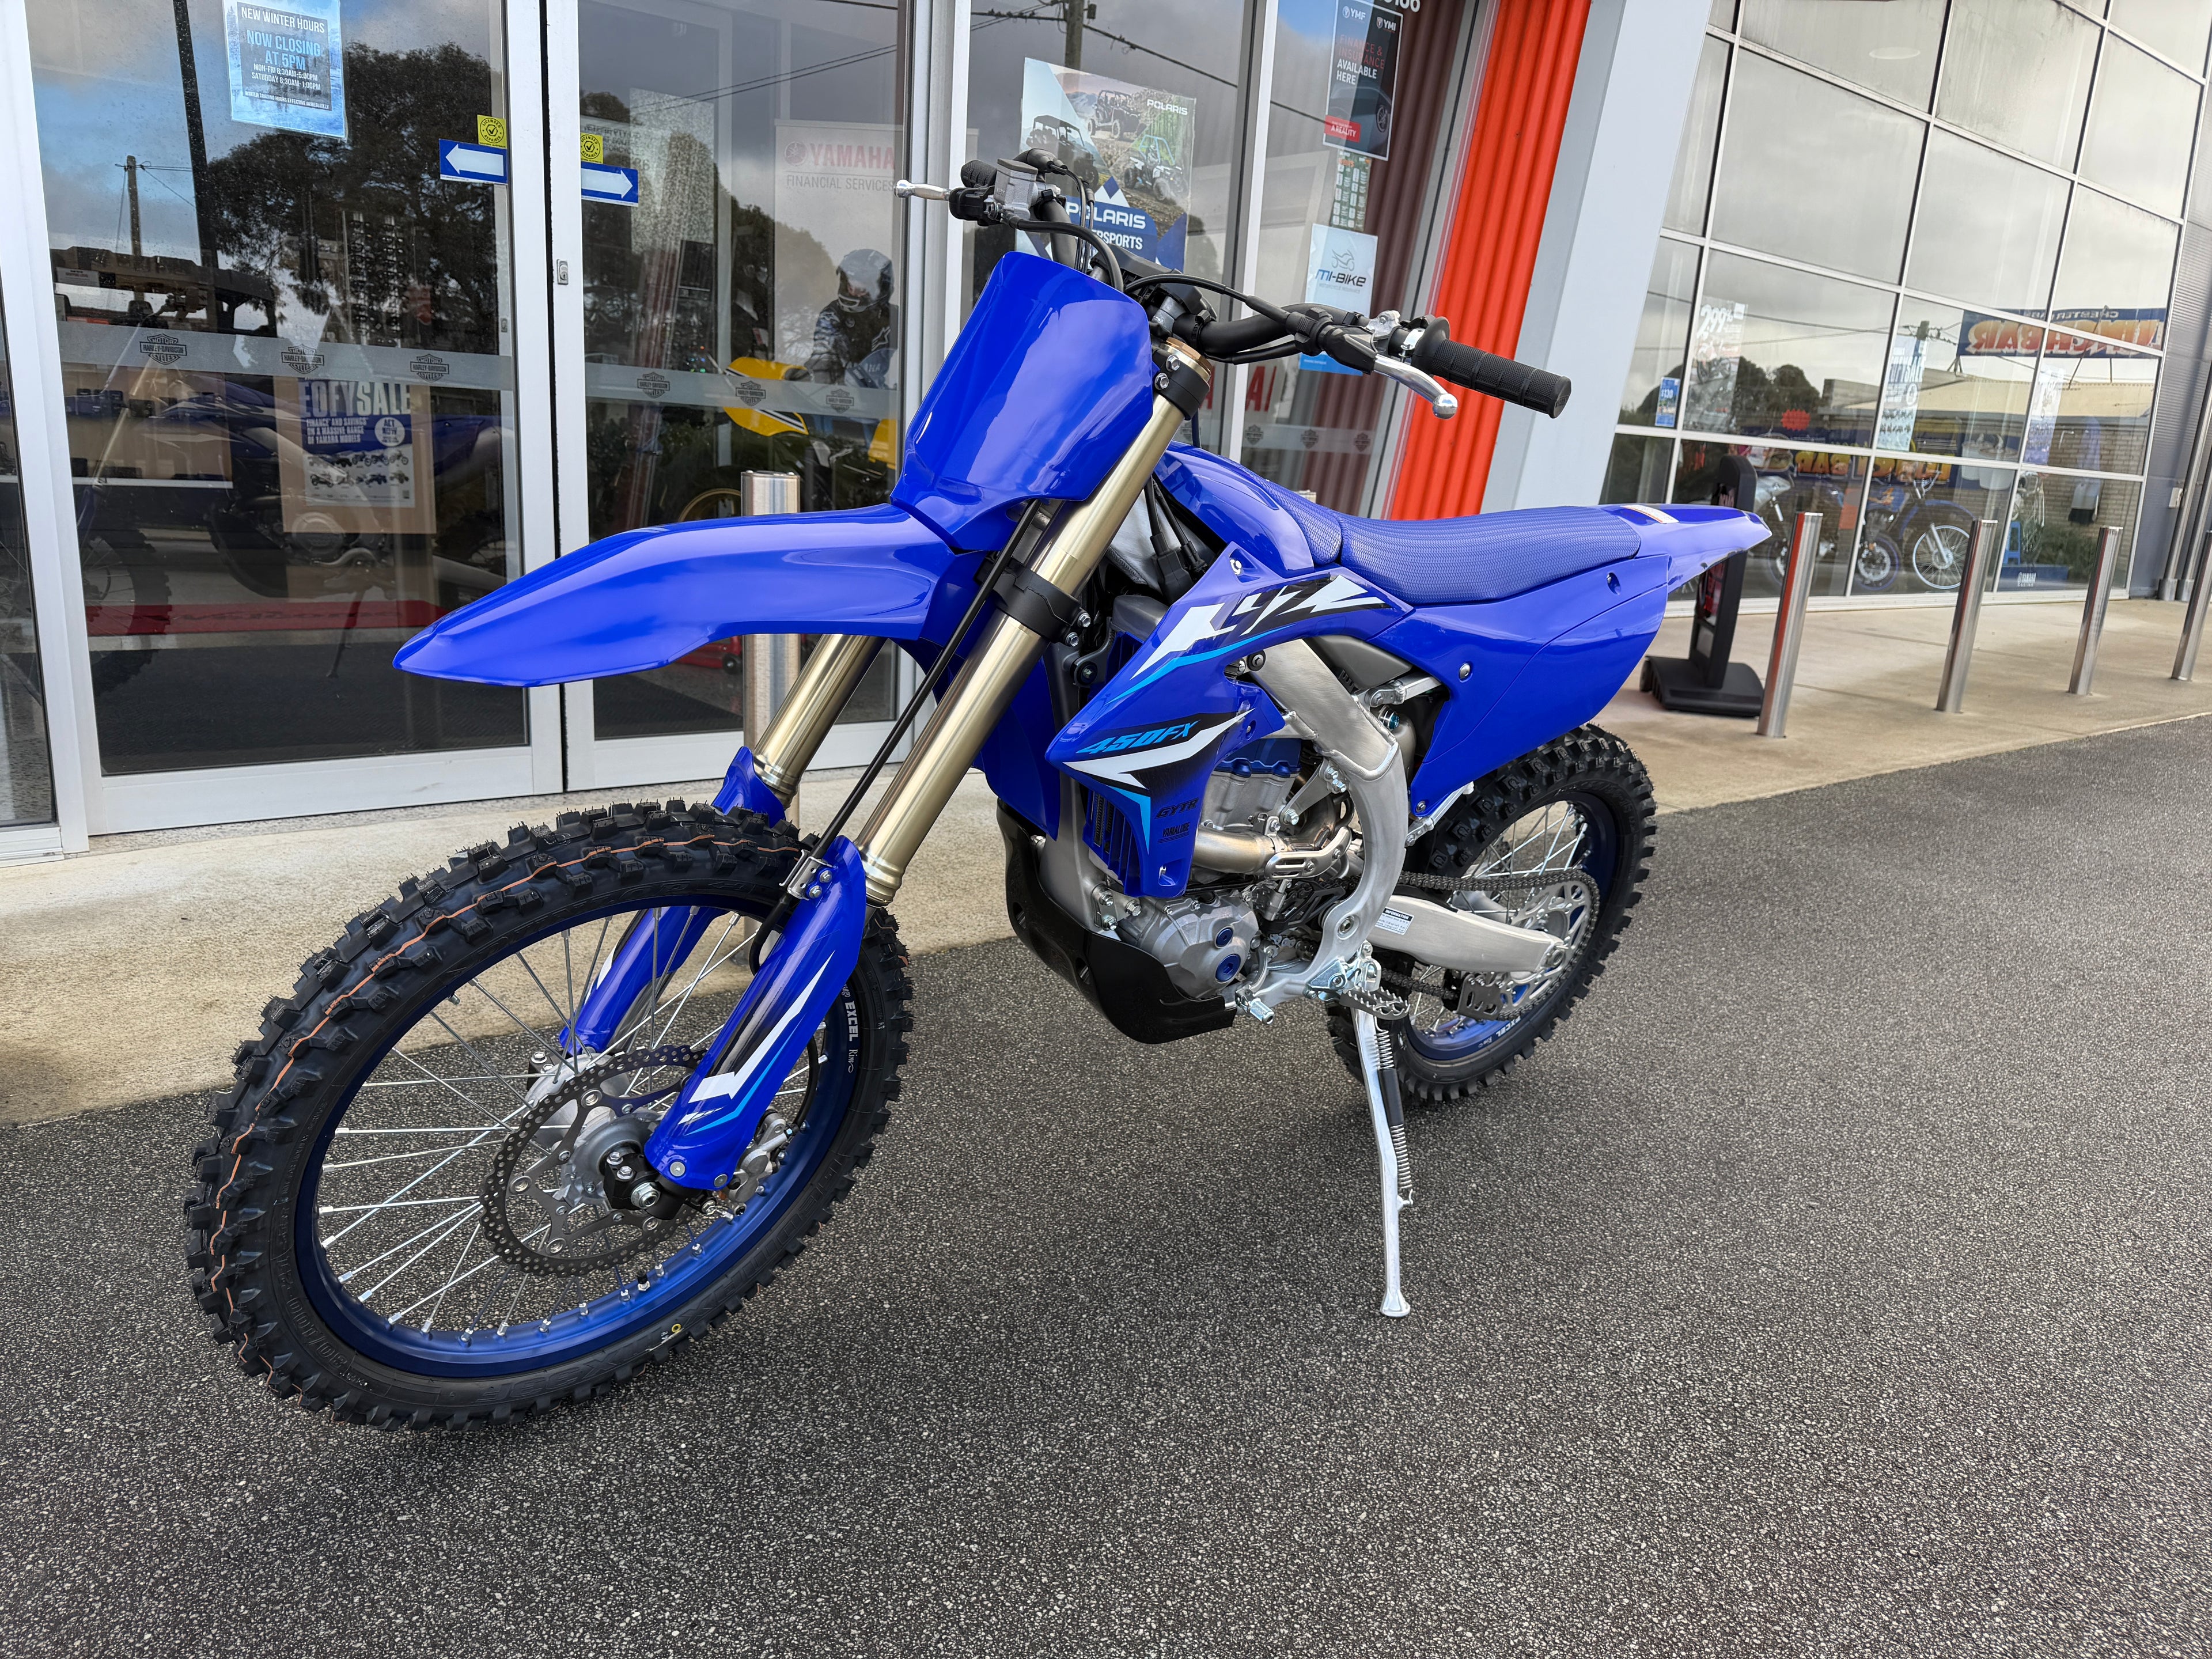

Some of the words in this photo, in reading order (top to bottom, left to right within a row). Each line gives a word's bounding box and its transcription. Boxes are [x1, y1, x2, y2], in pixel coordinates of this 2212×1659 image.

[241, 7, 260, 21] NEW
[263, 11, 296, 28] WINTER
[297, 18, 325, 33] HOURS
[1350, 8, 1366, 21] YMF
[1384, 19, 1396, 31] YMI
[247, 30, 272, 47] NOW
[275, 36, 321, 56] CLOSING
[1339, 34, 1376, 54] FINANCE
[1377, 46, 1382, 56] &
[253, 63, 276, 73] MON-FRI
[265, 50, 279, 65] AT
[282, 54, 305, 70] 5PM
[1339, 47, 1385, 69] INSURANCE
[252, 72, 279, 84] SATURDAY
[1336, 70, 1357, 85] HERE
[1337, 59, 1377, 79] AVAILABLE
[1146, 99, 1188, 115] POLARIS
[482, 119, 501, 128] LICENSED
[1336, 126, 1357, 137] REALITY
[810, 143, 895, 170] YAMAHA
[787, 175, 843, 189] FINANCIAL
[846, 178, 894, 192] SERVICES
[298, 380, 355, 418] EOFY
[356, 381, 411, 416] SALE
[1075, 719, 1201, 753] 450FX
[1155, 798, 1199, 819] GYTR
[1162, 823, 1190, 838] YAMALUBE
[1385, 909, 1410, 920] INFORMATION
[844, 1001, 859, 1041] EXCEL
[1495, 1016, 1521, 1037] EXCEL
